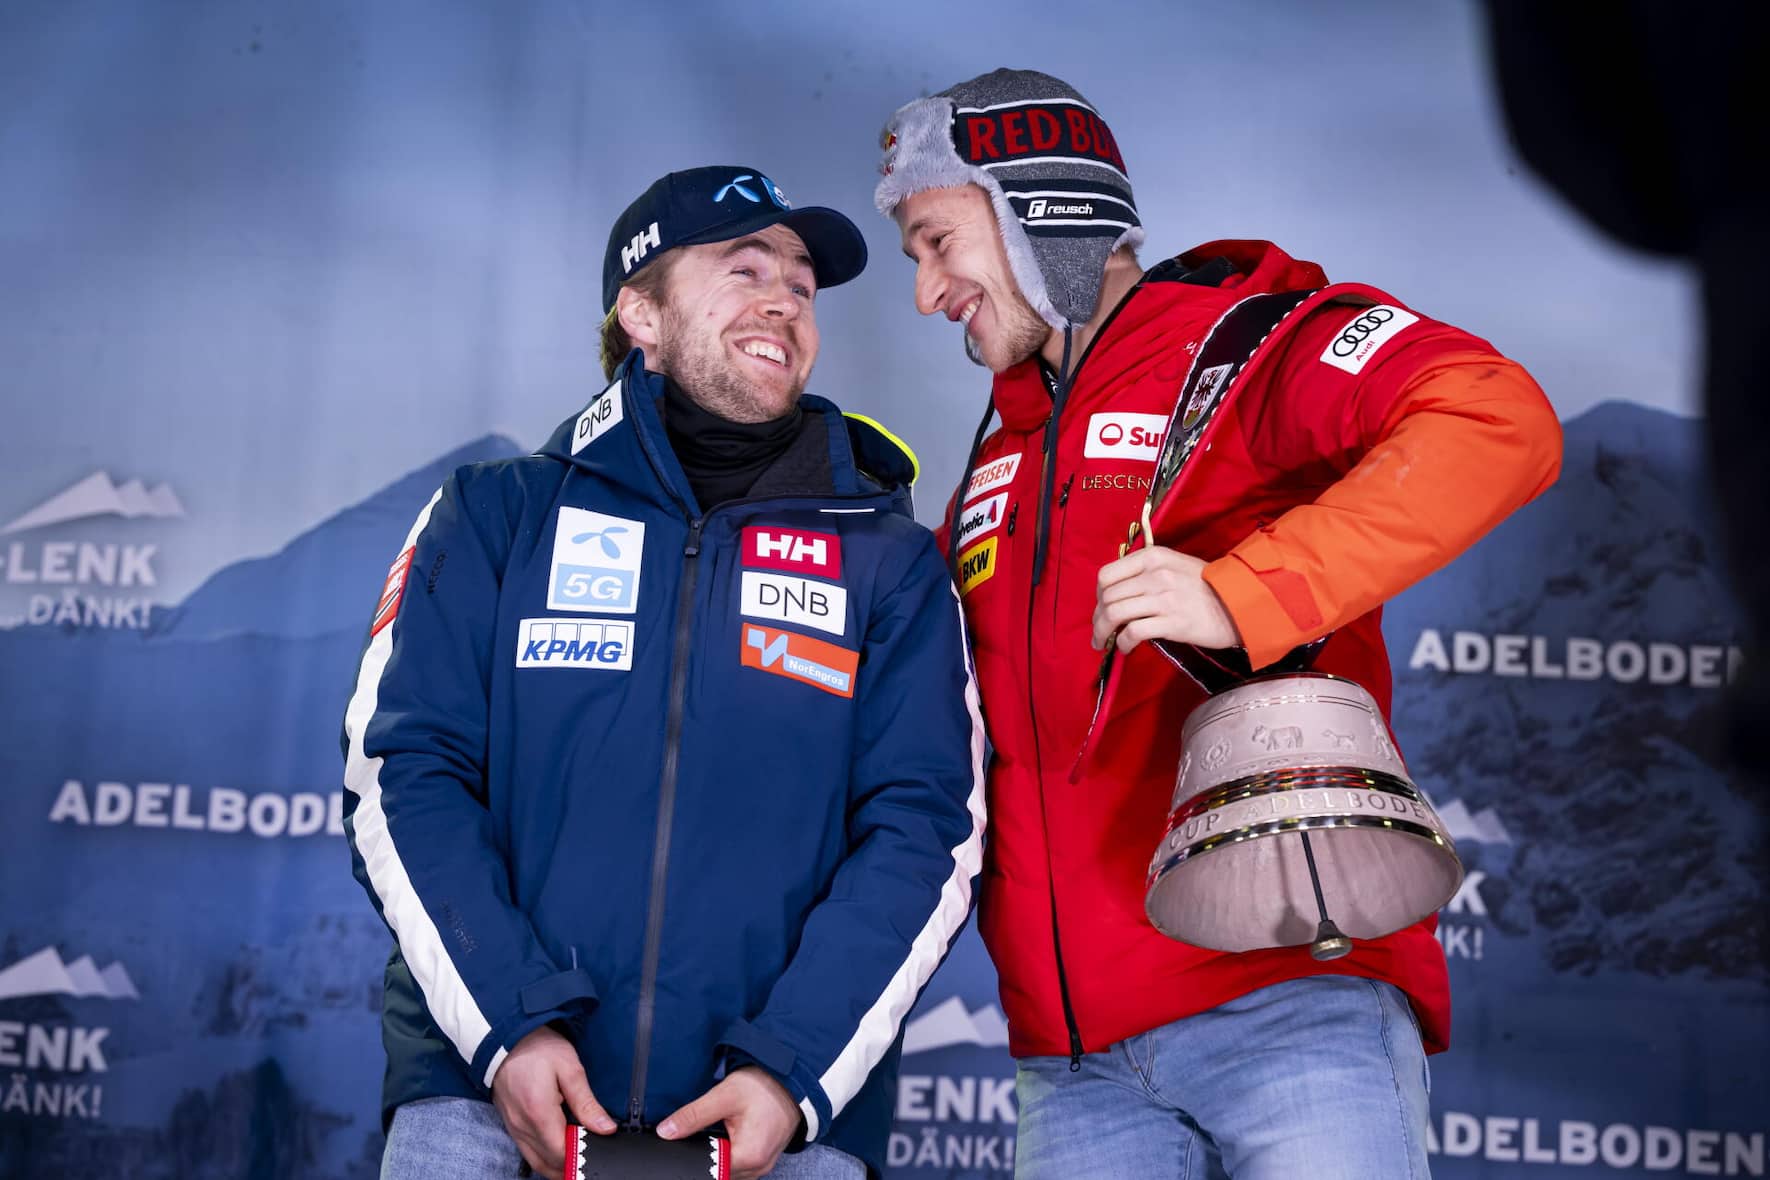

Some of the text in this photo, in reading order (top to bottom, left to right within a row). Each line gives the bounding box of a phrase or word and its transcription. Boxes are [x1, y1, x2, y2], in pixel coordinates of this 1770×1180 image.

[967, 108, 1062, 161] RED
[1047, 201, 1093, 216] reusch
[621, 222, 662, 274] HH
[1355, 340, 1376, 361] Audi
[579, 398, 612, 438] DNB
[756, 532, 827, 565] HH
[963, 548, 990, 583] BKW
[562, 573, 624, 601] 5G
[759, 581, 829, 617] DNB
[522, 639, 623, 663] KPMG
[788, 659, 844, 687] NorEngros
[1169, 812, 1222, 851] CUP
[0, 1073, 103, 1119] ÄNK!
[886, 1126, 1014, 1171] DÄNK!
